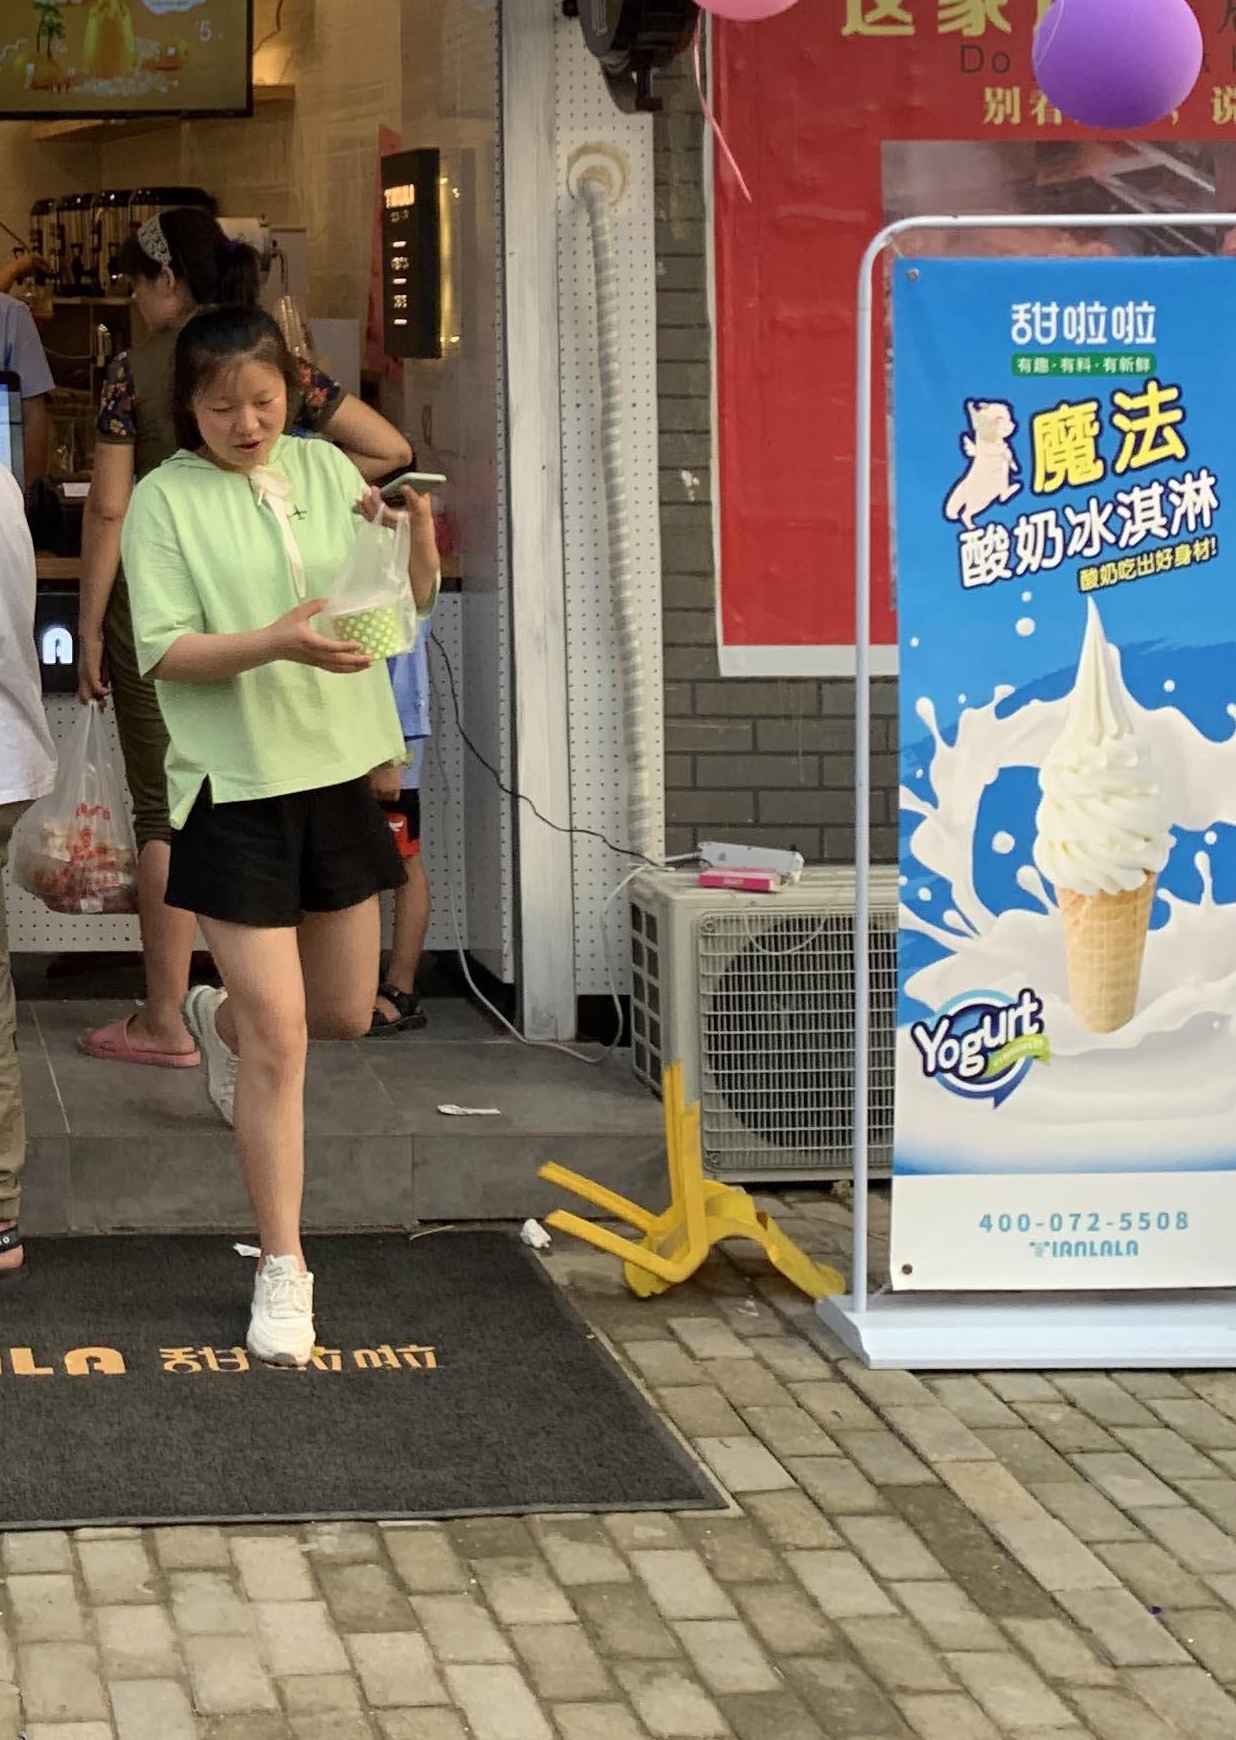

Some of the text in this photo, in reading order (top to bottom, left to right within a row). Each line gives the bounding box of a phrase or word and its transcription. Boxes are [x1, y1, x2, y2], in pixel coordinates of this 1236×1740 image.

[961, 44, 1011, 74] Do
[1011, 301, 1157, 346] 甜啦啦
[1032, 379, 1188, 495] 魔法
[959, 467, 1220, 589] 酸奶冰淇淋
[912, 988, 1044, 1078] Yogurt
[978, 1210, 1190, 1233] 400-072-5508
